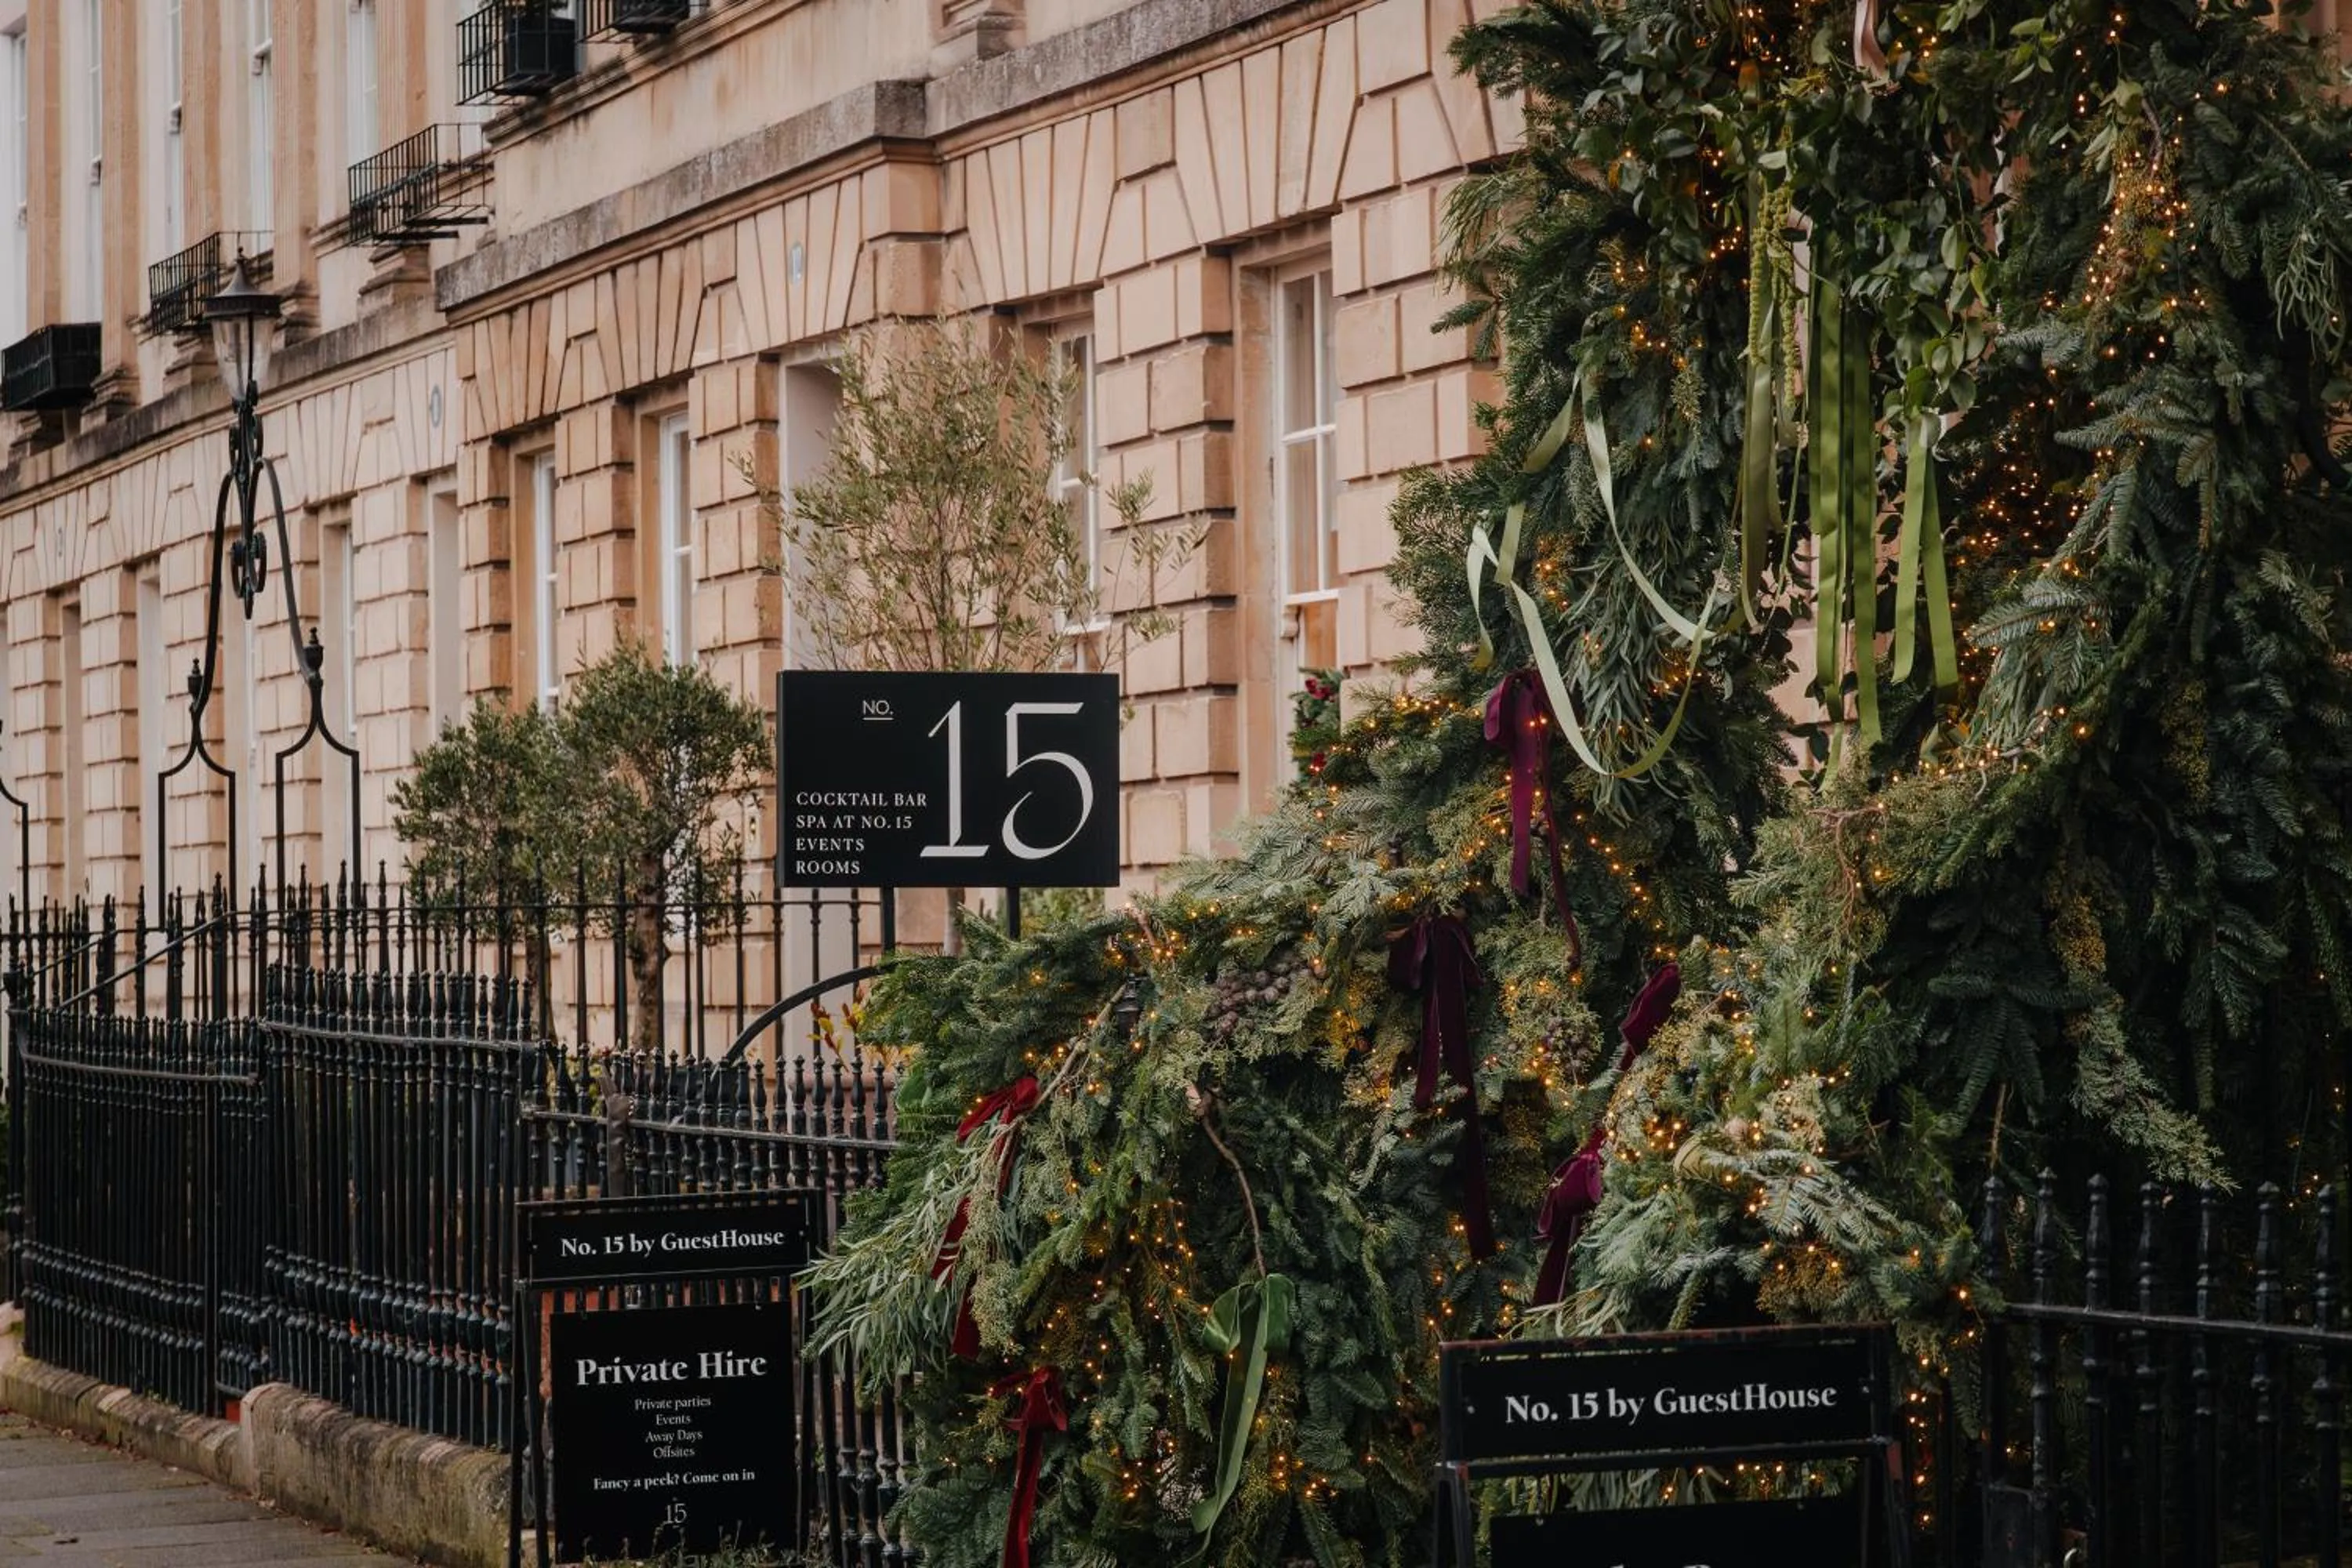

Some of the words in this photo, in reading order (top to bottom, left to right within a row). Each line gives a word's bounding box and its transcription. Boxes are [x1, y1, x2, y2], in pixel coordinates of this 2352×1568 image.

[862, 700, 894, 716] NO.
[920, 700, 1094, 860] 15
[796, 792, 887, 807] COCKTAIL
[894, 793, 927, 807] BAR
[796, 815, 826, 829] SPA
[833, 815, 855, 829] AT
[862, 815, 891, 829] NO.
[895, 815, 913, 829] 15
[795, 838, 865, 851] EVENTS
[795, 860, 860, 875] ROOMS
[561, 1236, 597, 1258] No.
[604, 1236, 624, 1254] 15
[630, 1232, 654, 1258] by
[661, 1229, 785, 1251] GuestHouse
[576, 1356, 688, 1385] Private
[697, 1350, 768, 1380] Hire
[634, 1398, 673, 1410] Private
[674, 1396, 712, 1411] parties
[1504, 1395, 1559, 1424] No.
[1568, 1391, 1599, 1421] 15
[1608, 1387, 1646, 1425] by
[1653, 1383, 1838, 1416] GuestHouse
[655, 1414, 691, 1425] Events
[645, 1431, 674, 1444] Away
[677, 1429, 703, 1443] Days
[653, 1445, 695, 1458] Offsites
[593, 1478, 630, 1491] Fancy
[633, 1478, 641, 1488] a
[644, 1472, 680, 1490] peek?
[682, 1471, 719, 1485] Come
[722, 1473, 739, 1483] on
[742, 1468, 756, 1481] in
[665, 1502, 688, 1524] 15
